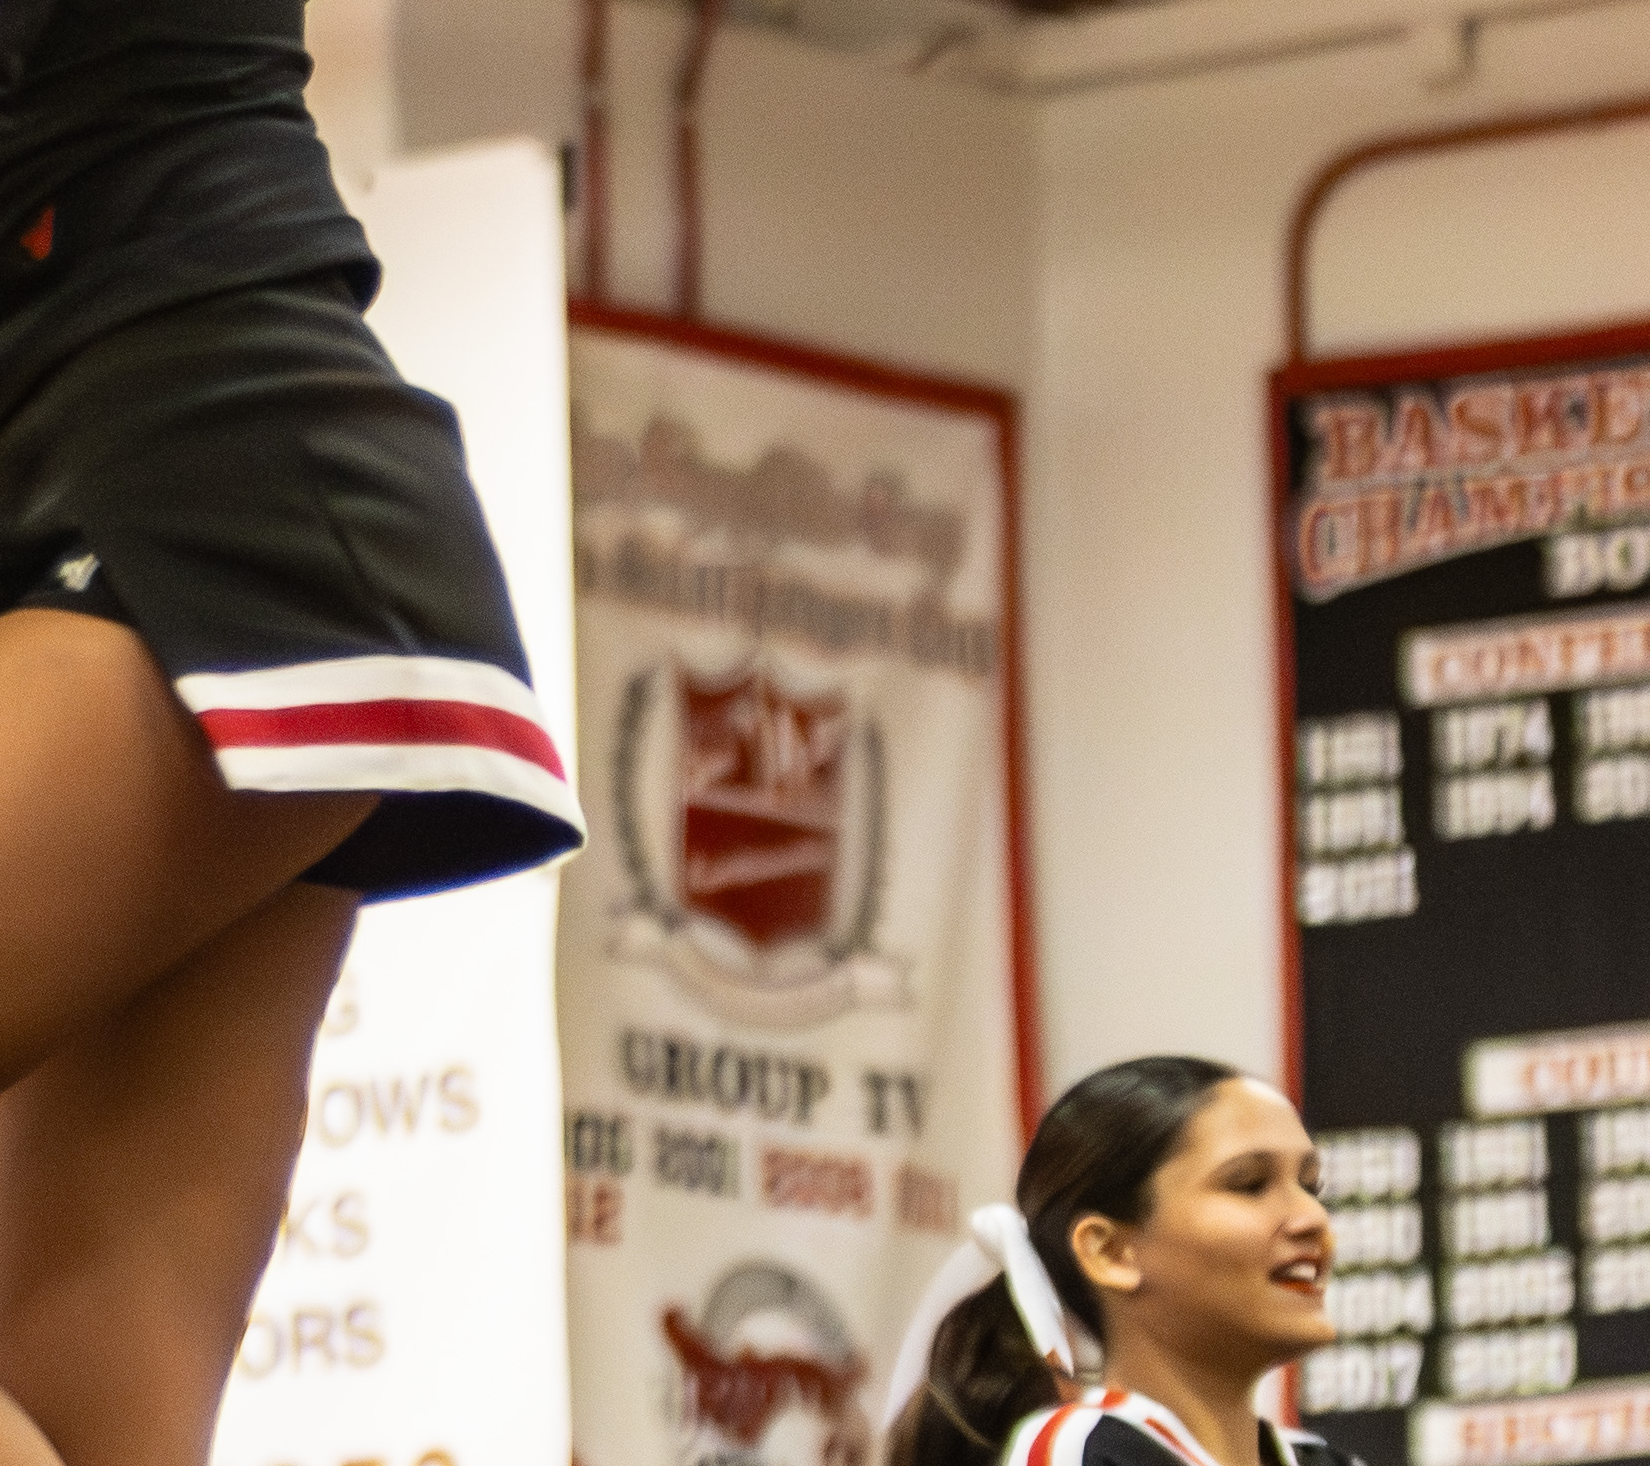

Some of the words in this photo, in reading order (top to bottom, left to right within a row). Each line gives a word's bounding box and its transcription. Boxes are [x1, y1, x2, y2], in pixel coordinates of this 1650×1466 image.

[314, 1061, 484, 1150] OWS
[619, 1028, 836, 1130] GROUP
[287, 1189, 372, 1260] KS
[232, 1298, 388, 1382] ORS
